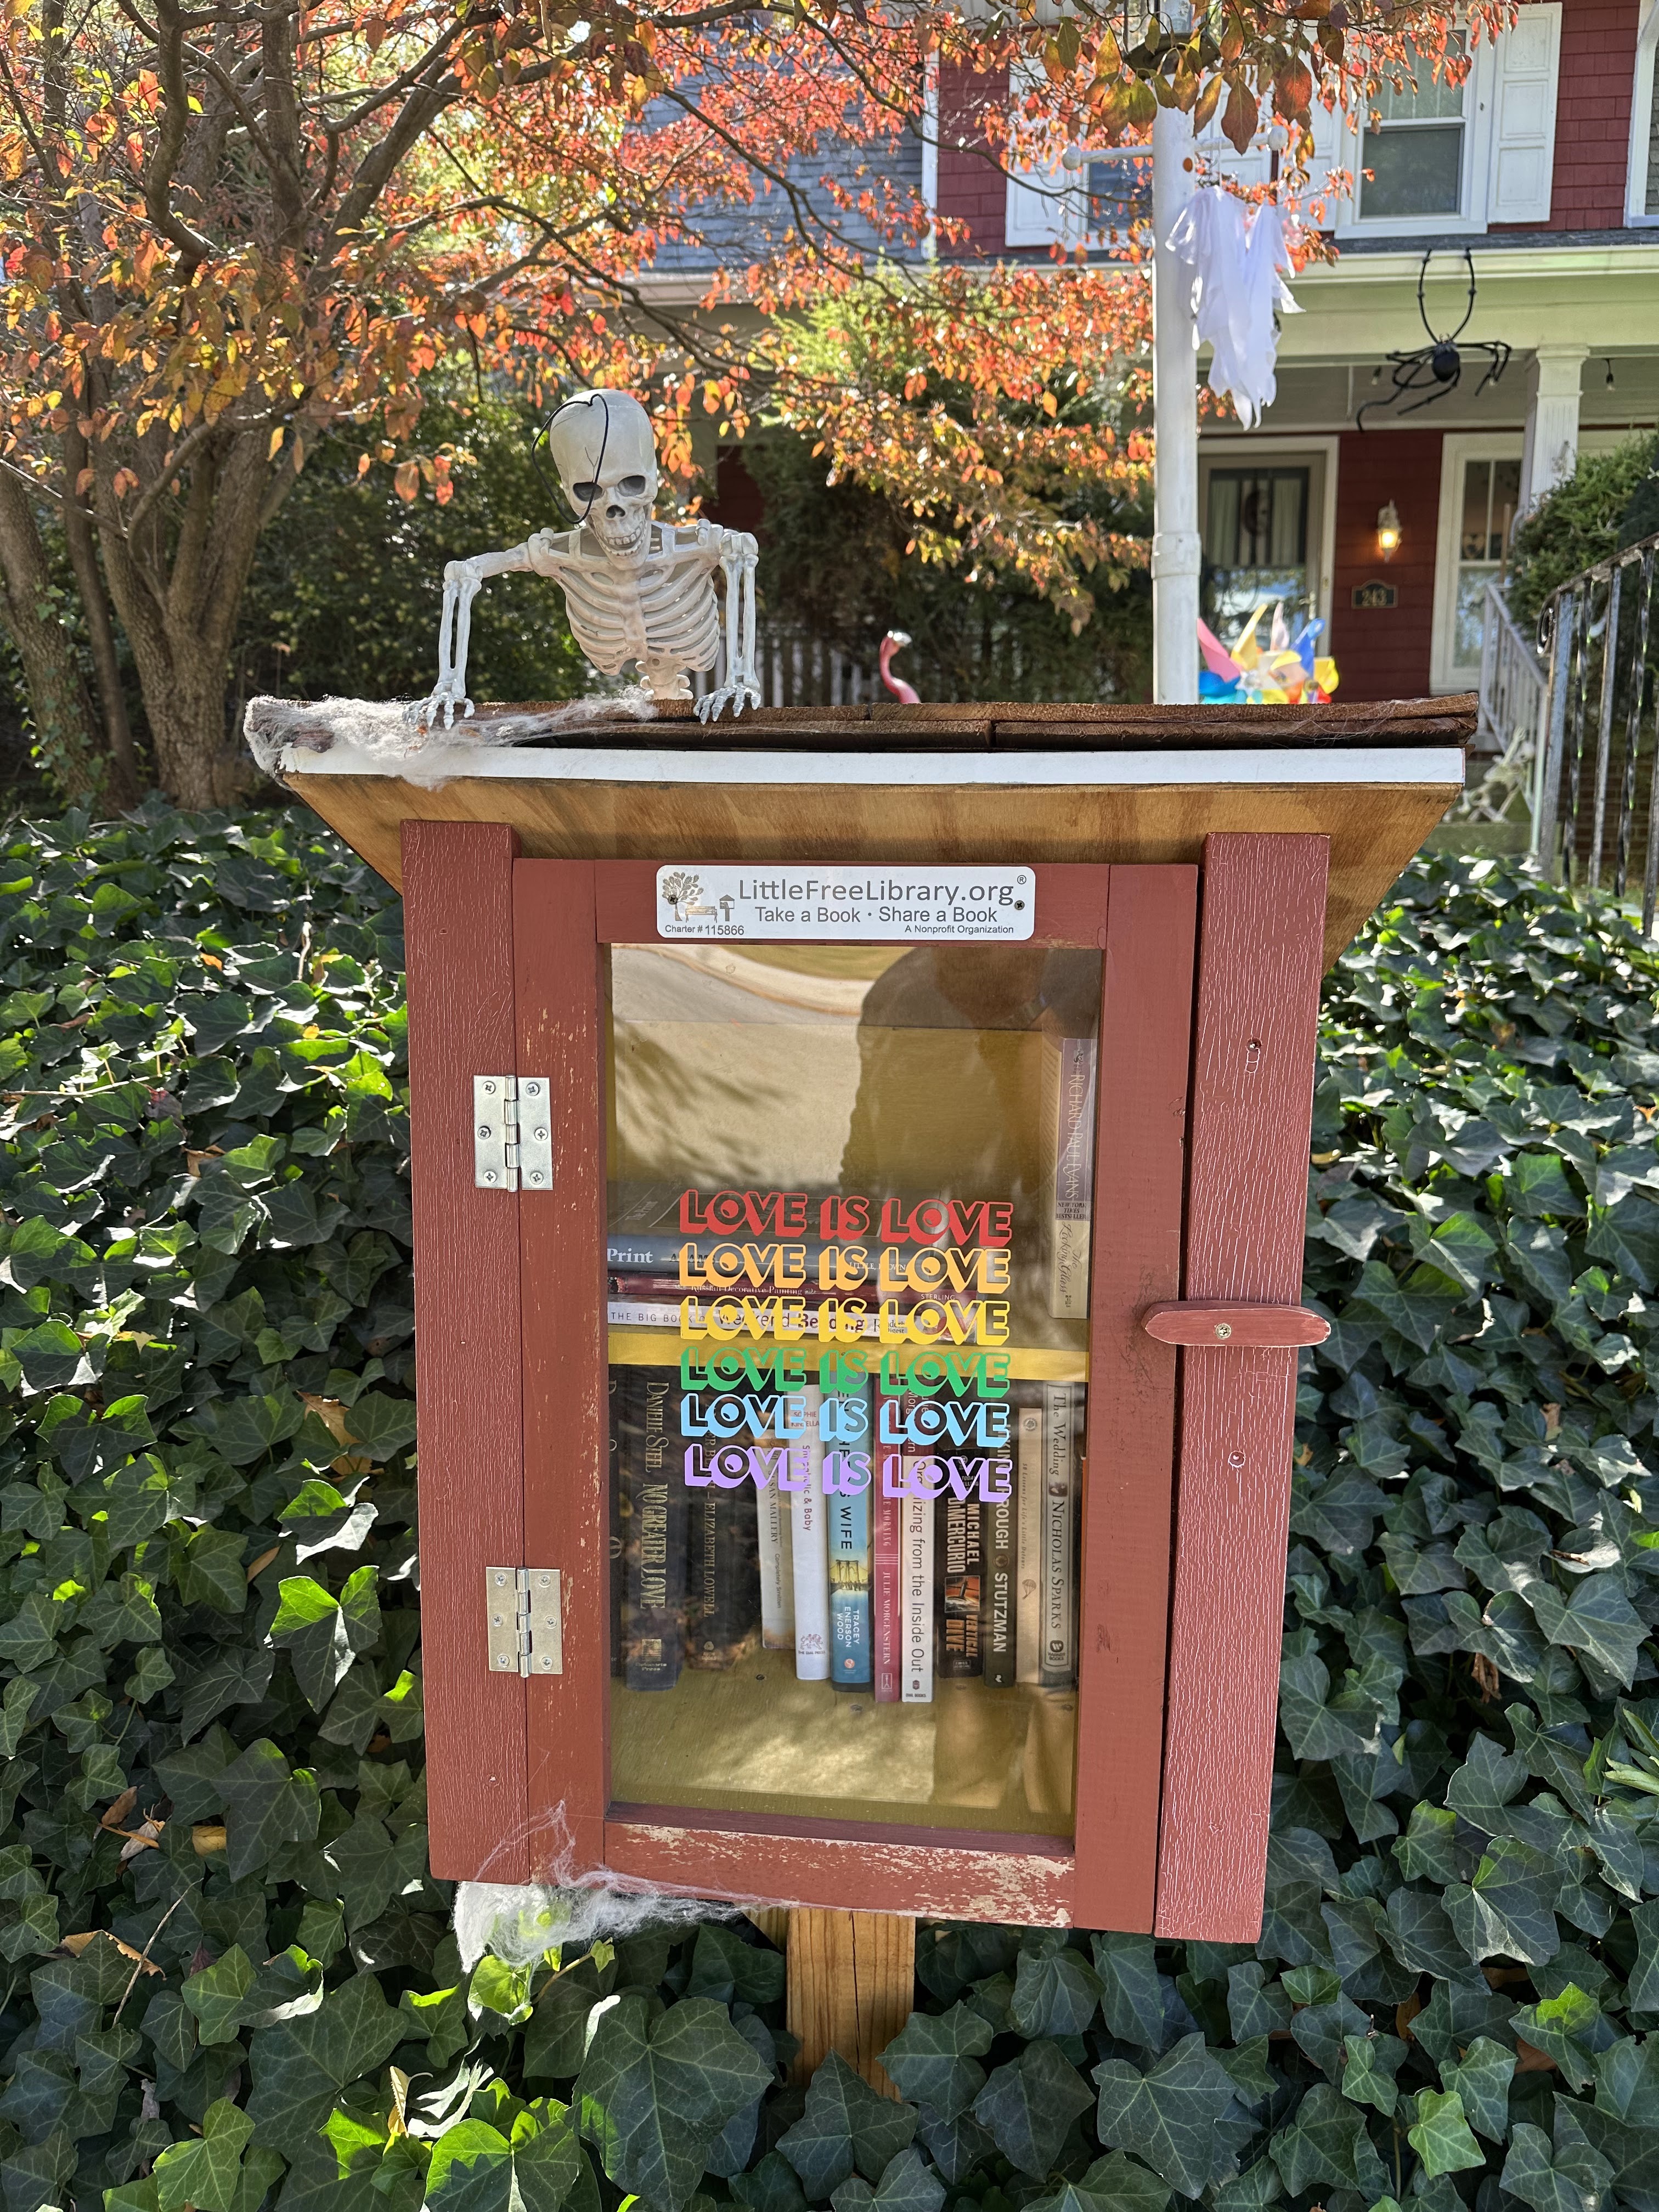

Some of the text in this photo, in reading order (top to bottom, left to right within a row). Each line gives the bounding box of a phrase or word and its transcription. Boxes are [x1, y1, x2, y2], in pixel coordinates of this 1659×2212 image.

[665, 924, 696, 933] Charter
[705, 925, 744, 935] 115866
[755, 907, 997, 922] Take a Book Share a Book
[905, 925, 1014, 935] A Nonprofit Organization
[1068, 1074, 1085, 1130] RICHARD
[1066, 1133, 1083, 1161] PAUL
[1063, 1163, 1081, 1199] EVANS
[680, 1189, 1013, 1248] LOVE IS LOVE
[607, 1248, 654, 1263] Print
[669, 1253, 716, 1264] AAMS
[1057, 1221, 1073, 1263] Looking
[1072, 1249, 1082, 1270] The
[679, 1242, 1011, 1294] LOVE IS LOVE
[1058, 1262, 1072, 1294] Glass
[769, 1286, 803, 1296] Painting
[611, 1312, 631, 1321] THE
[639, 1313, 657, 1322] BIG
[663, 1314, 693, 1323] BOK
[718, 1310, 790, 1328] Weend
[798, 1313, 865, 1334] Bedng
[680, 1295, 1010, 1346] LOVE IS LOVE
[680, 1346, 1011, 1398] LOVE IS LOVE
[645, 1381, 670, 1472] DANIELLE STEEL
[680, 1393, 806, 1439] LOVE
[819, 1397, 868, 1442] IS
[879, 1401, 1010, 1447] LOVE
[906, 1389, 918, 1453] Morgrn
[1049, 1393, 1066, 1476] The Wedding
[685, 1443, 810, 1491] LOVE
[822, 1452, 871, 1495] IS
[883, 1454, 1013, 1503] LOVE
[704, 1449, 715, 1488] BEH
[769, 1502, 778, 1544] MALLERY
[803, 1508, 813, 1531] Baby
[840, 1506, 853, 1550] WIFE
[883, 1509, 891, 1547] MORNING
[966, 1503, 980, 1565] MICHAEL
[995, 1483, 1009, 1549] ROUGH
[636, 1483, 668, 1610] NO GREATER LOVE
[703, 1502, 715, 1618] ELIZABETH LOWELL
[909, 1461, 926, 1672] Orgizing from the Inside Out
[1051, 1500, 1065, 1629] NICHOLAS SPARKS
[882, 1595, 891, 1666] MORGENSTERN
[993, 1573, 1007, 1652] STUTZMAN
[945, 1620, 964, 1651] DIVE
[965, 1615, 978, 1657] VERTICAL
